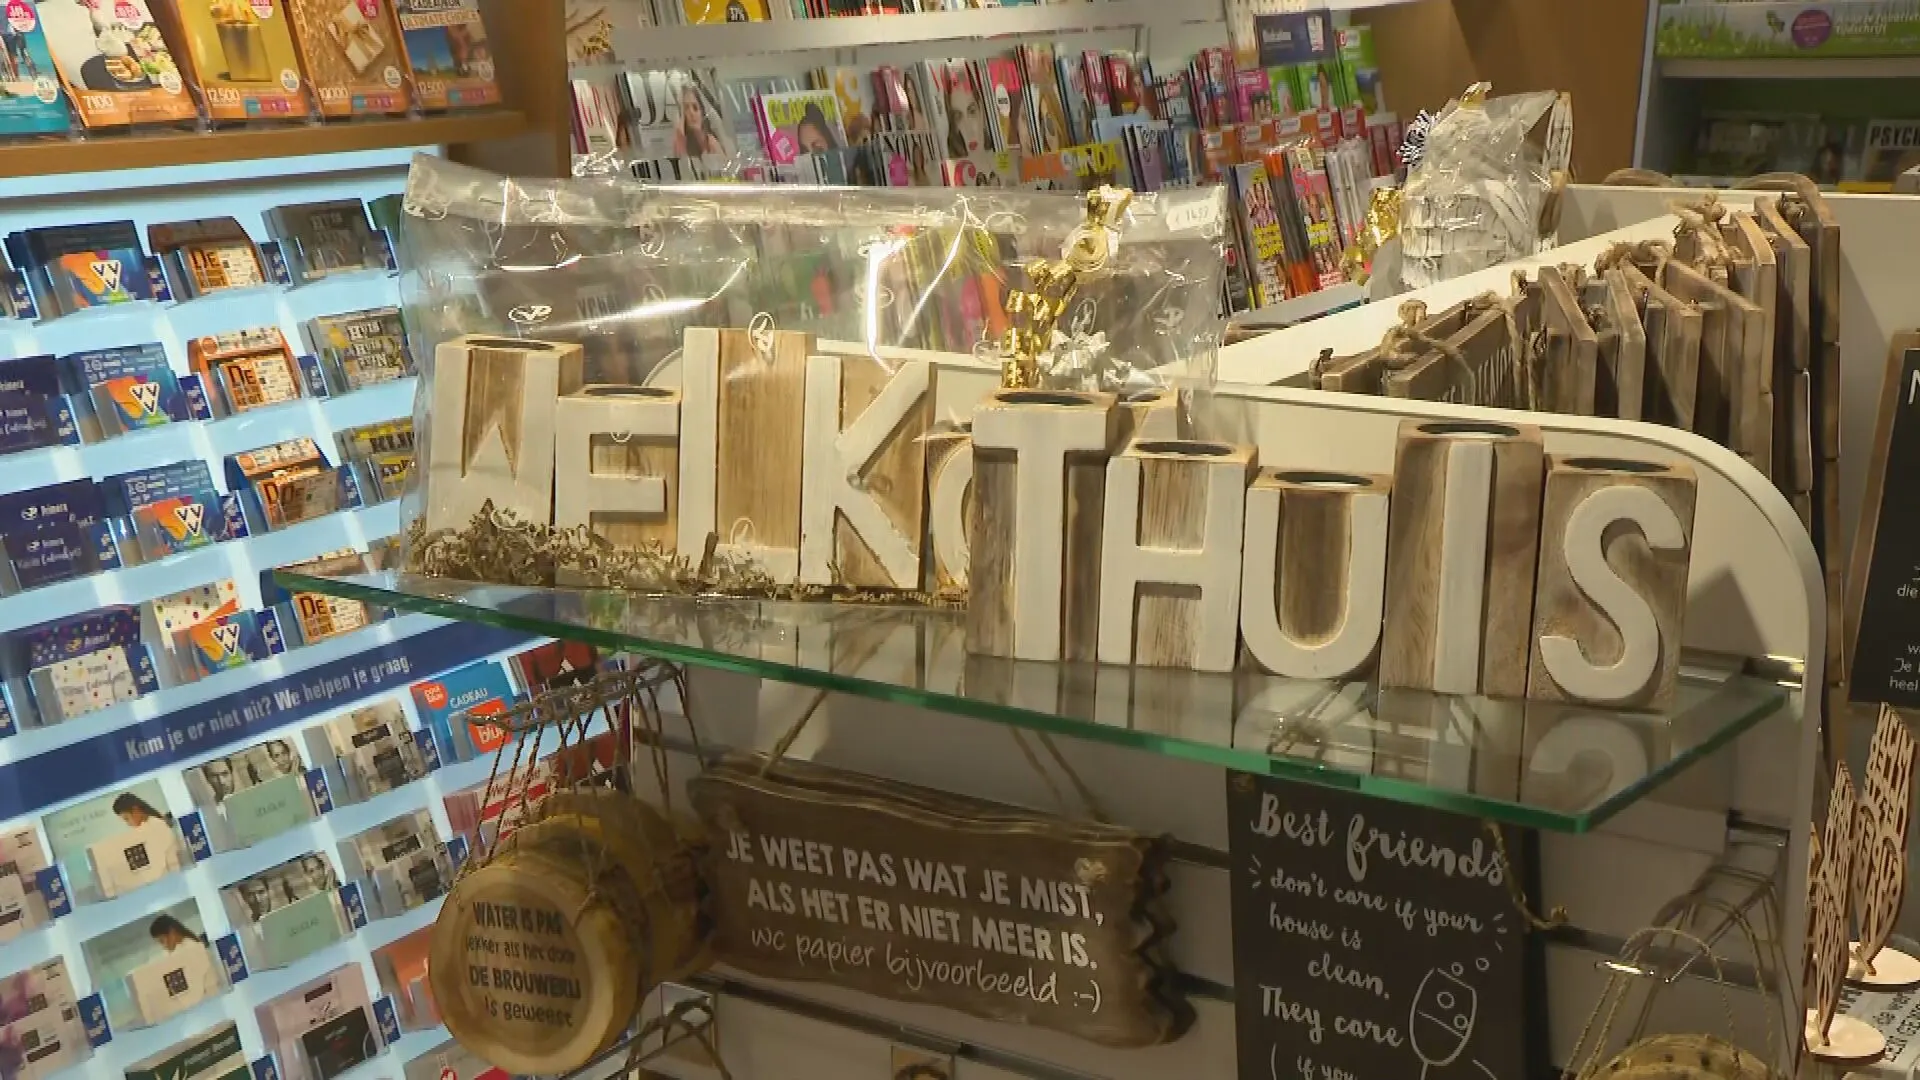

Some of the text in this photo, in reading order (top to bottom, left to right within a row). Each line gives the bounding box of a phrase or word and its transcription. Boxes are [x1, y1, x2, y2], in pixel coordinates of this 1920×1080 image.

[768, 95, 836, 125] GLAMR
[969, 406, 1687, 701] THUIS
[125, 654, 414, 762] Kom je er niet uit? We helpen je graag.
[449, 687, 489, 709] CADEAU
[1251, 792, 1505, 887] Best friends
[726, 830, 1104, 927] JE WEET PAS WAT JE MIST,
[1271, 868, 1484, 937] don't care if your
[473, 901, 519, 932] WATER
[521, 907, 534, 934] IS
[748, 878, 1098, 969] ALS HET ER NIET MEER IS.
[1270, 902, 1362, 950] house is
[469, 964, 489, 988] DE
[751, 927, 786, 951] wc
[797, 931, 876, 974] papier
[886, 942, 1059, 1006] bijvoorbeeld
[1308, 953, 1390, 1000] clean.
[1259, 983, 1403, 1047] They care
[1297, 1054, 1315, 1080] if
